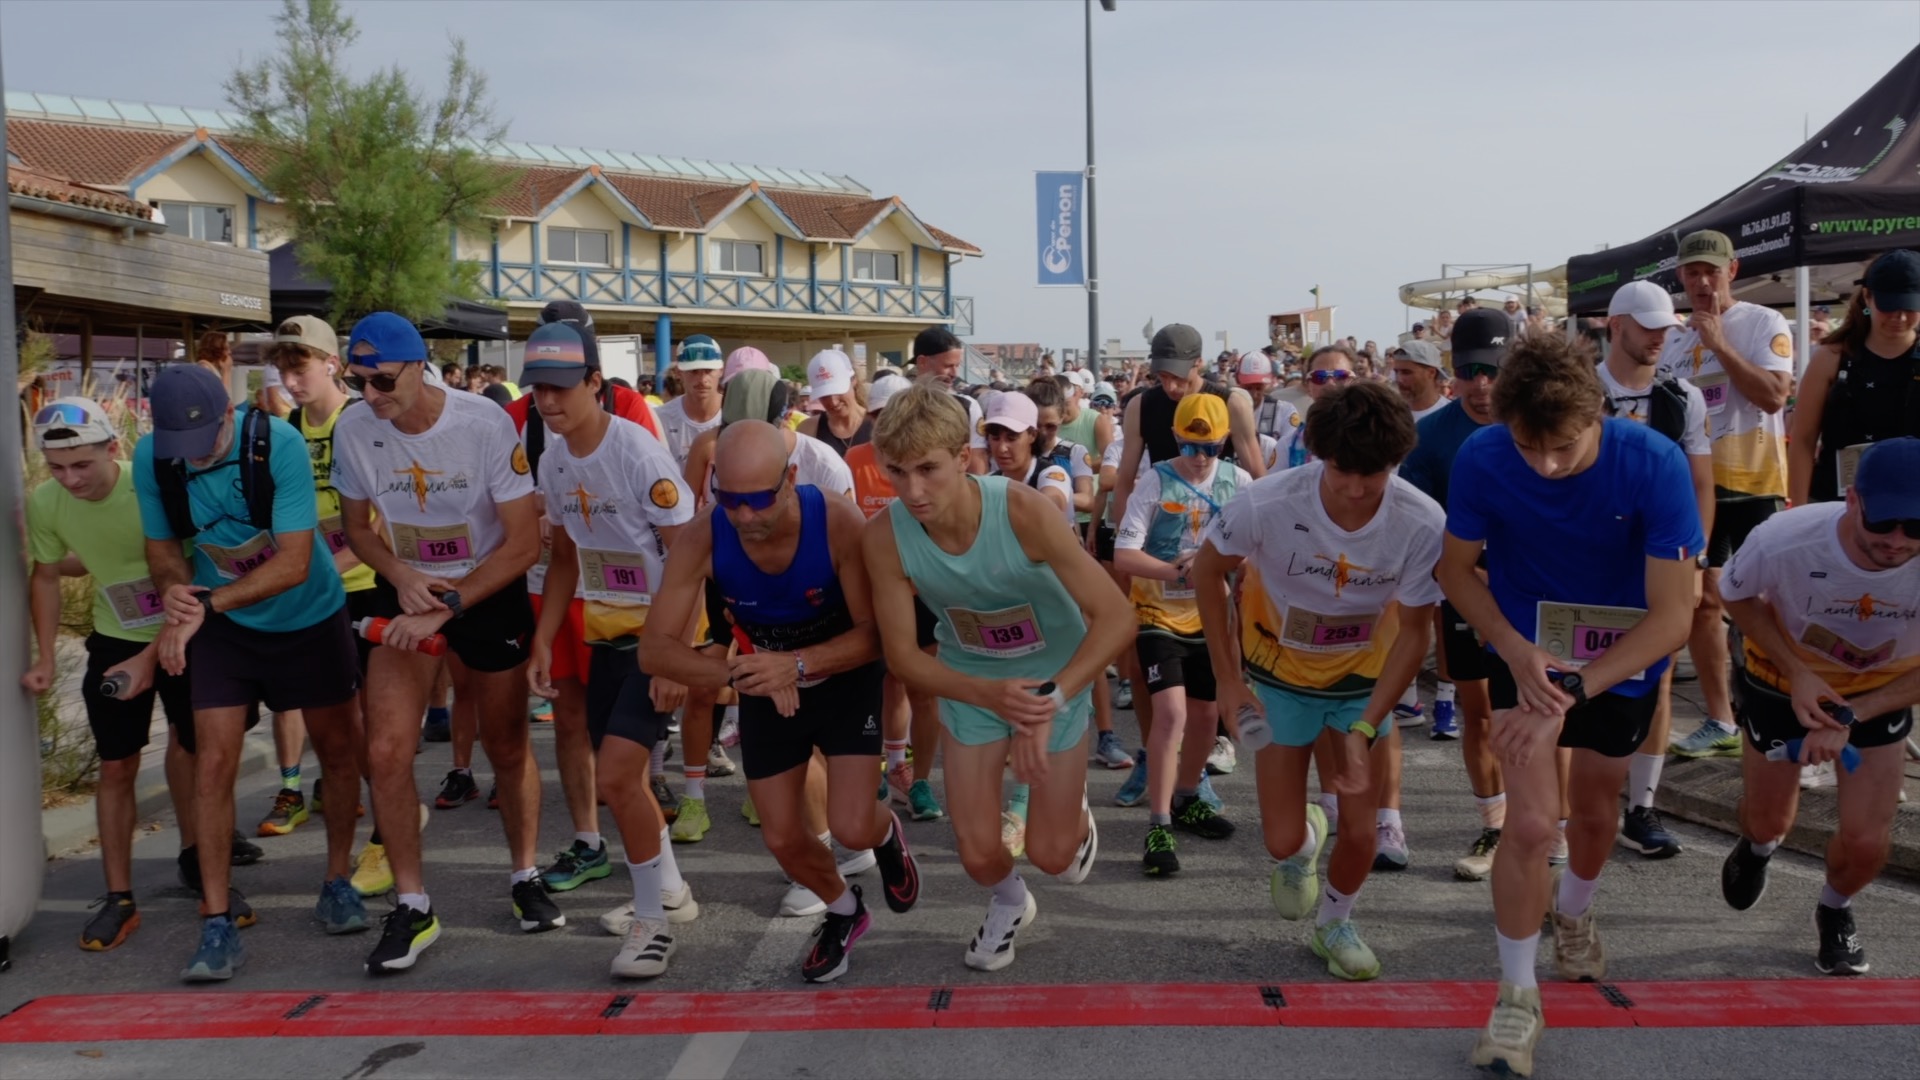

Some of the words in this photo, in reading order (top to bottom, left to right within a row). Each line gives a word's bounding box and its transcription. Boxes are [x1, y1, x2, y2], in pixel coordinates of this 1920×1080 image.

[1056, 185, 1072, 250] Penon
[220, 293, 262, 310] SEIGNOSSE
[427, 541, 458, 557] 126
[613, 569, 638, 586] 191
[989, 626, 1024, 643] 139
[1323, 626, 1362, 641] 253
